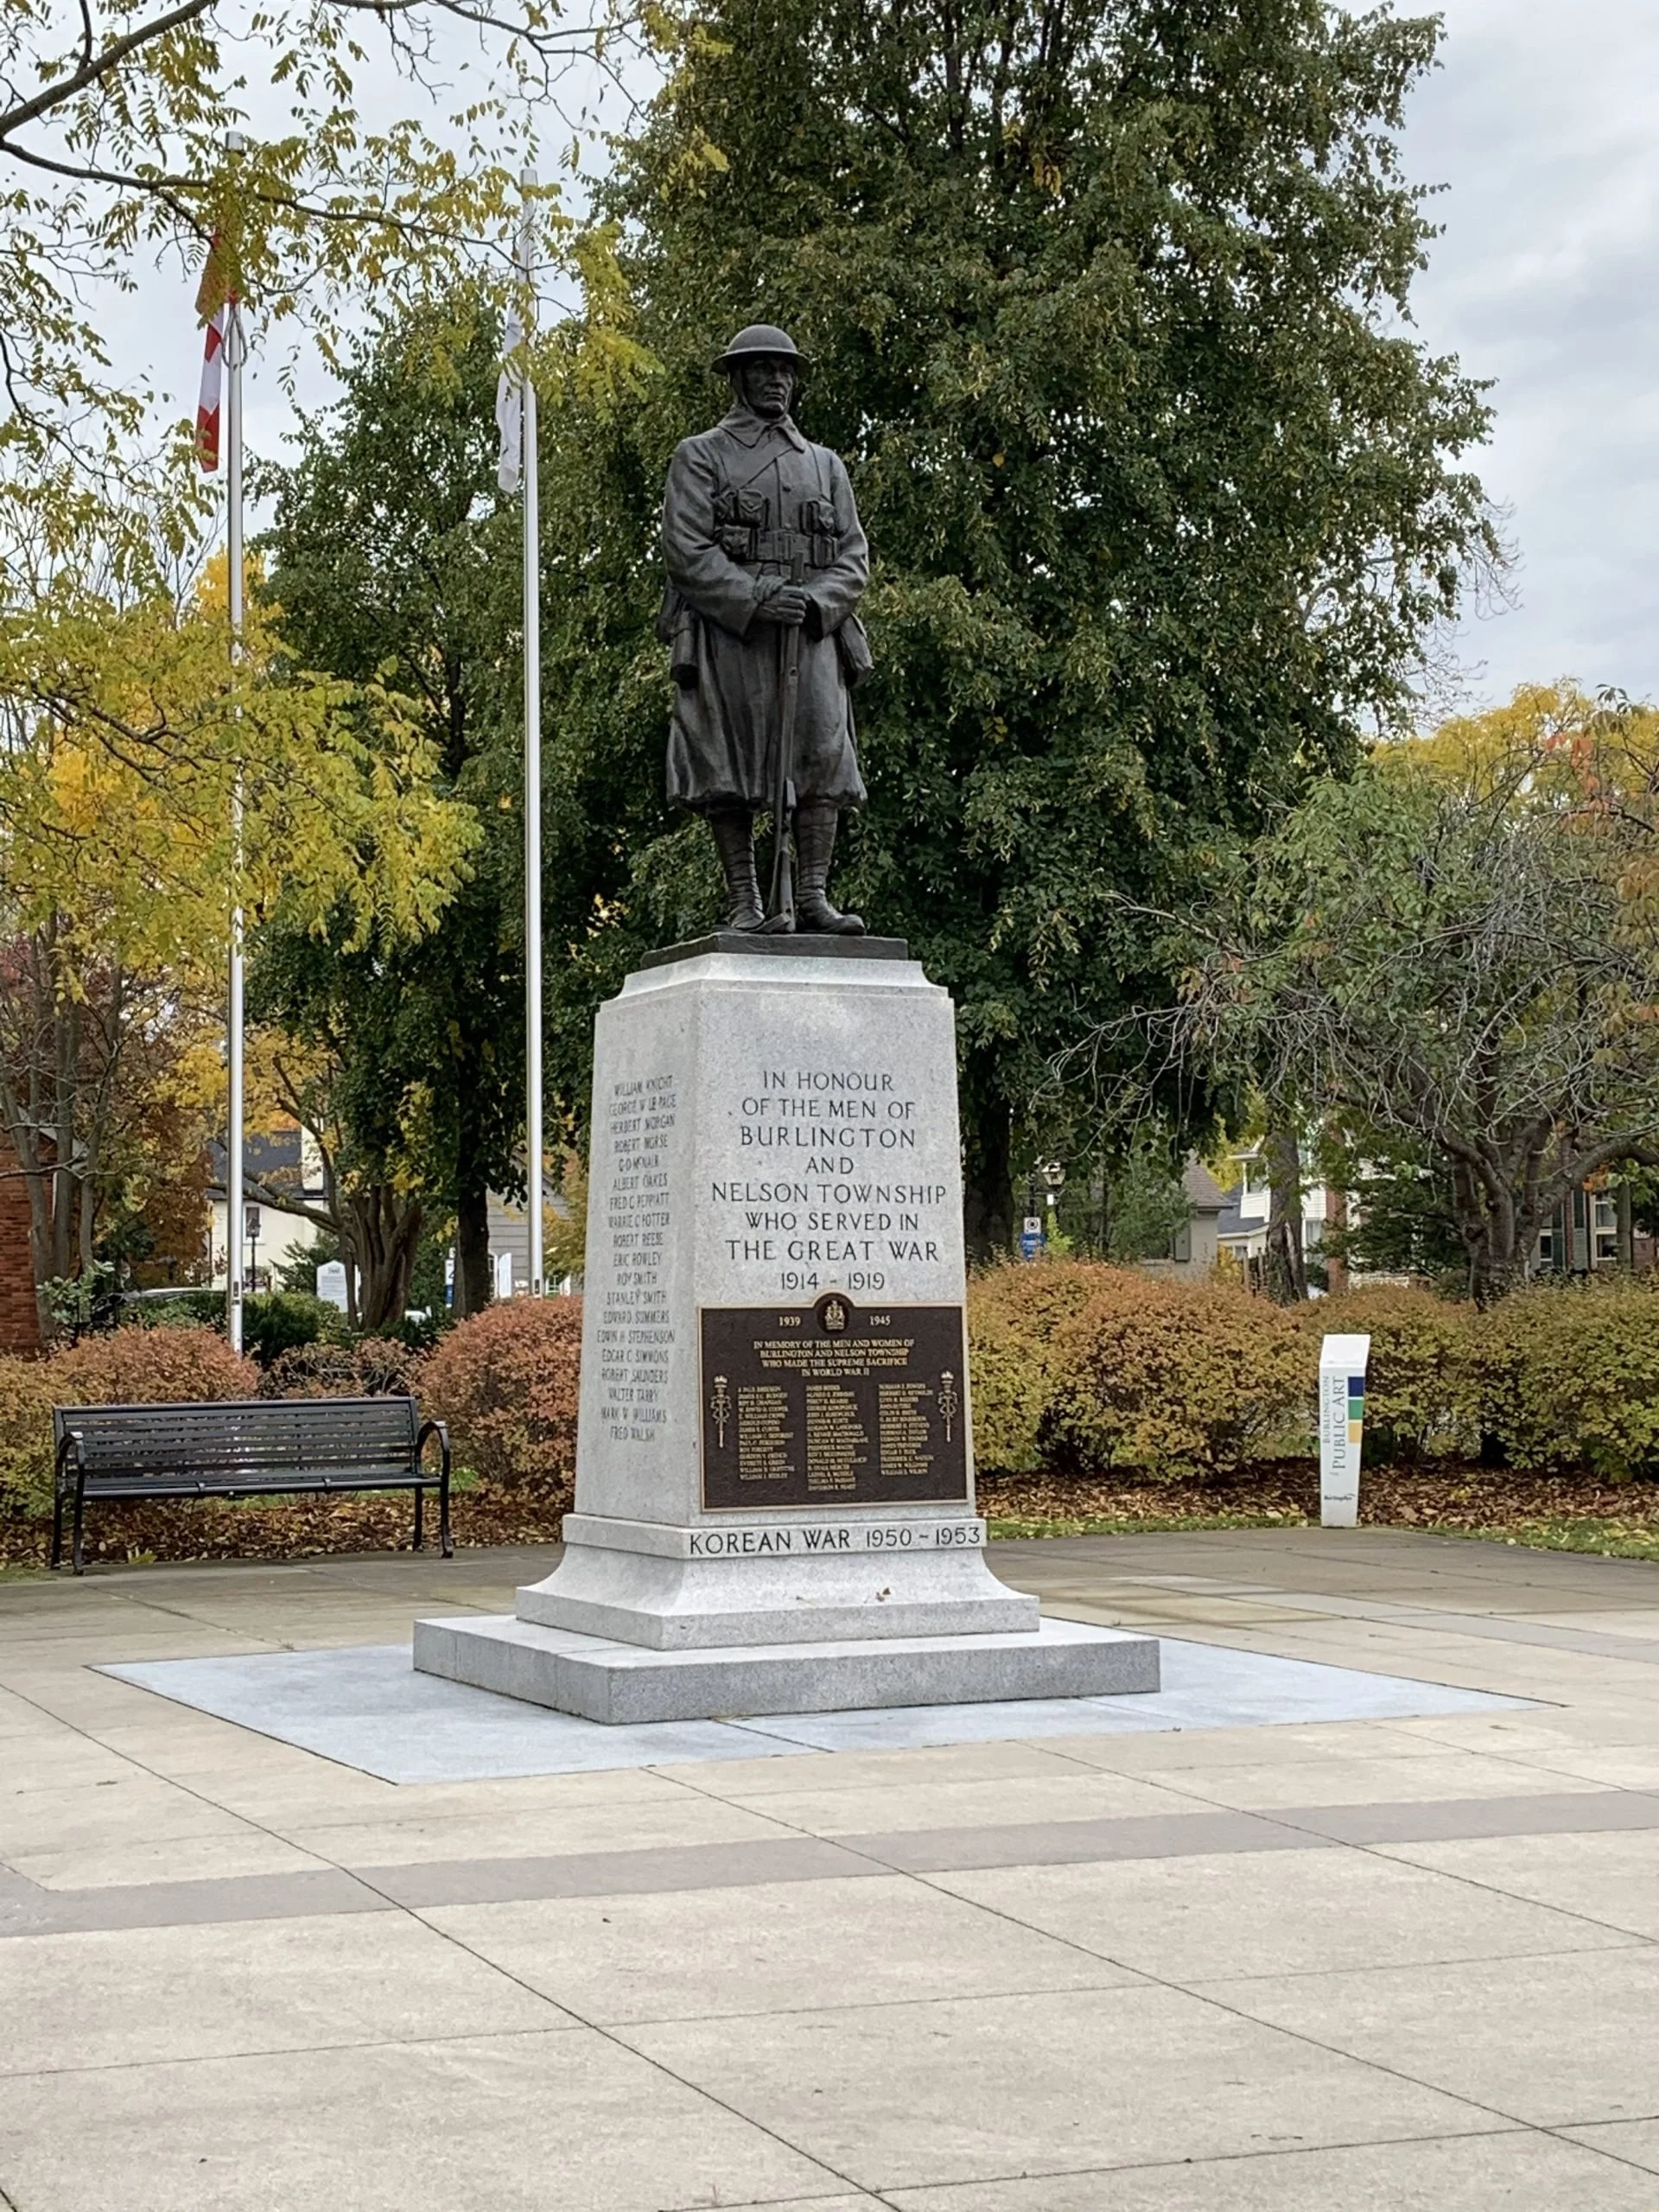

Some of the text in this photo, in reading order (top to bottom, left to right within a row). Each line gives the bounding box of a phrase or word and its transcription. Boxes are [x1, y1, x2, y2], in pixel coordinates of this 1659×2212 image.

[764, 1071, 894, 1091] IN HONOUR
[742, 1097, 915, 1120] OF THE MEN OF
[741, 1127, 915, 1148] BURLINGTON
[806, 1157, 855, 1174] AND
[613, 1176, 639, 1191] ALBERT
[713, 1183, 946, 1205] NELSON TOWNSHIP
[610, 1197, 627, 1211] FRED
[643, 1212, 671, 1227] POTTER
[747, 1212, 918, 1230] WHO SERVED IN
[726, 1240, 939, 1262] THE GREAT WAR
[613, 1254, 629, 1267] ERIC
[617, 1273, 632, 1286] ROY
[781, 1273, 819, 1290] 1914
[848, 1273, 885, 1291] 1919
[607, 1290, 666, 1306] STANLEY SMITH
[779, 1316, 801, 1326] 1939
[870, 1315, 891, 1326] 1945
[760, 1350, 814, 1358] BURLINGTON
[1332, 1376, 1346, 1470] PUBLIC ART
[690, 1531, 791, 1555] KOREAN
[803, 1529, 850, 1548] WAR
[867, 1529, 912, 1546] 1950
[936, 1527, 980, 1545] 1953
